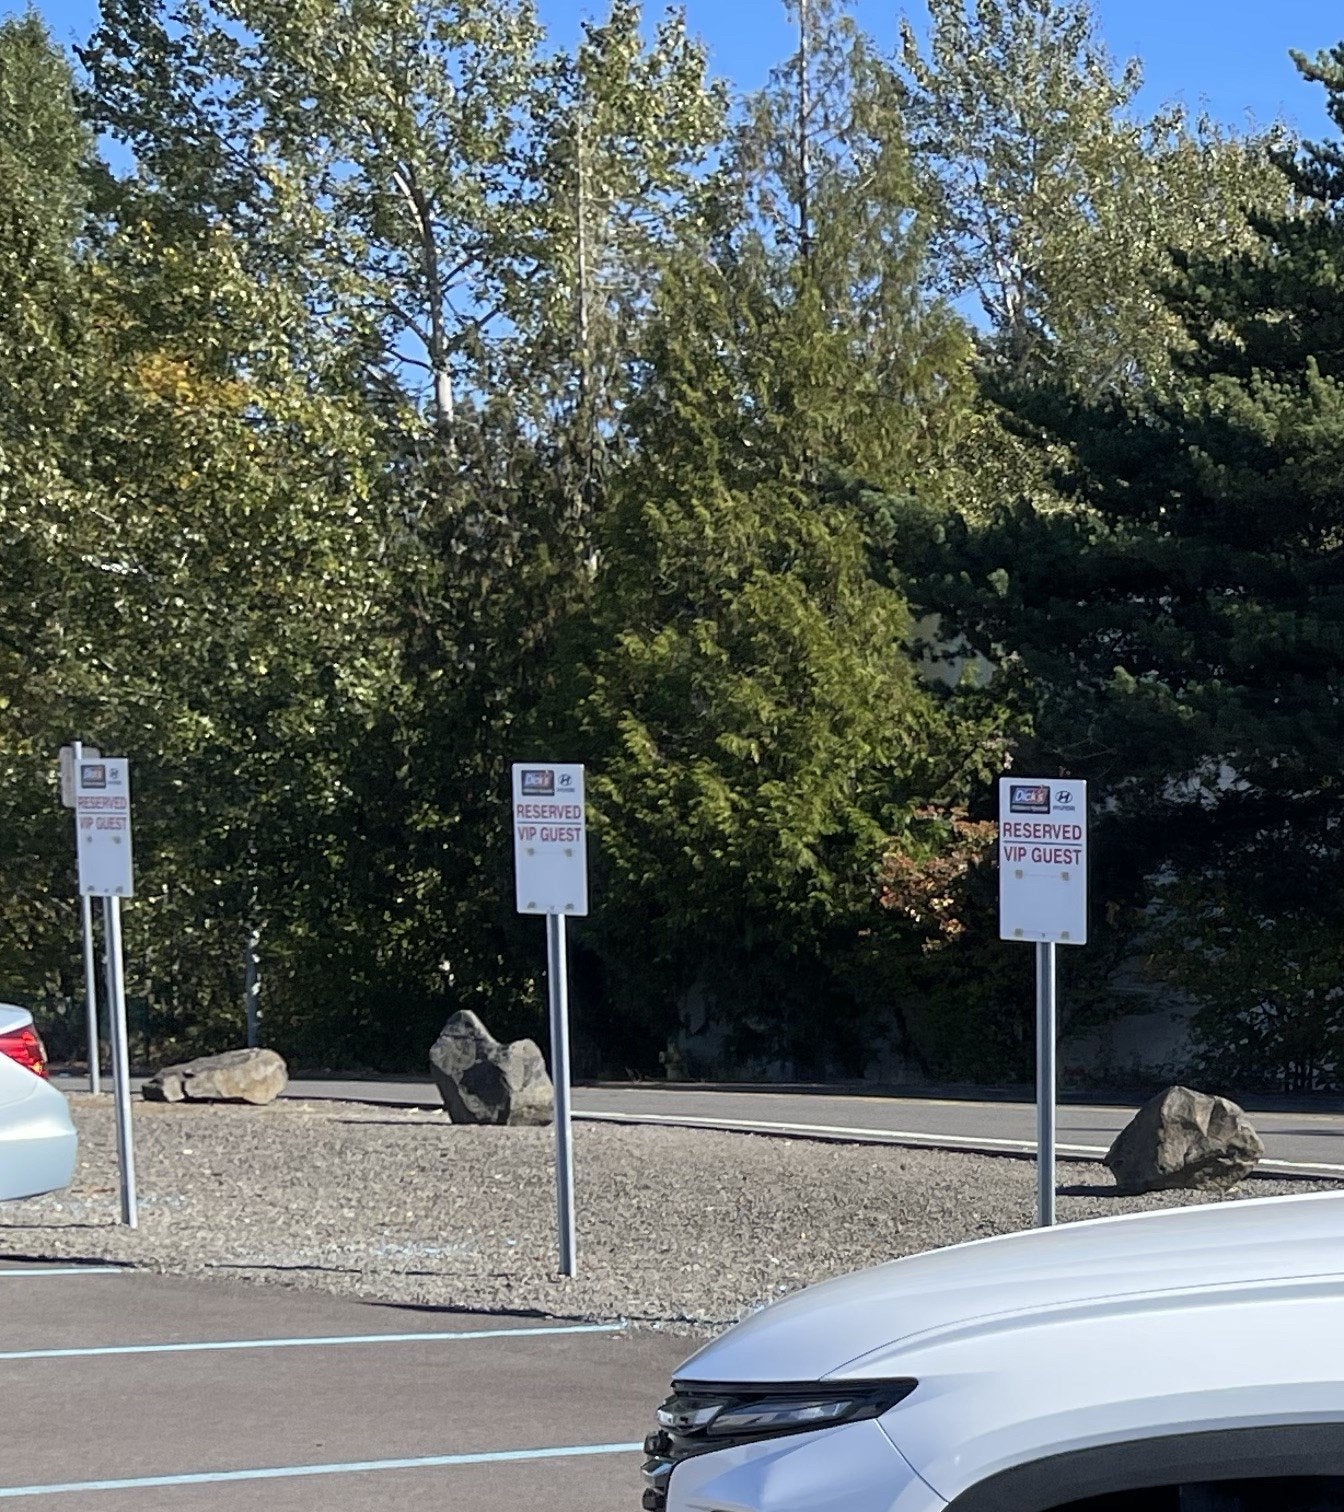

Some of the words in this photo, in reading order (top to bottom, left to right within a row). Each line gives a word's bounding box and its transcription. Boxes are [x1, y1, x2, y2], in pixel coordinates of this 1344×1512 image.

[516, 803, 582, 820] RESERVED
[517, 826, 537, 842] VIP
[540, 827, 582, 842] GUEST
[1002, 821, 1083, 841] RESERVED
[1003, 846, 1028, 862] VIP
[1031, 847, 1082, 865] GUEST
